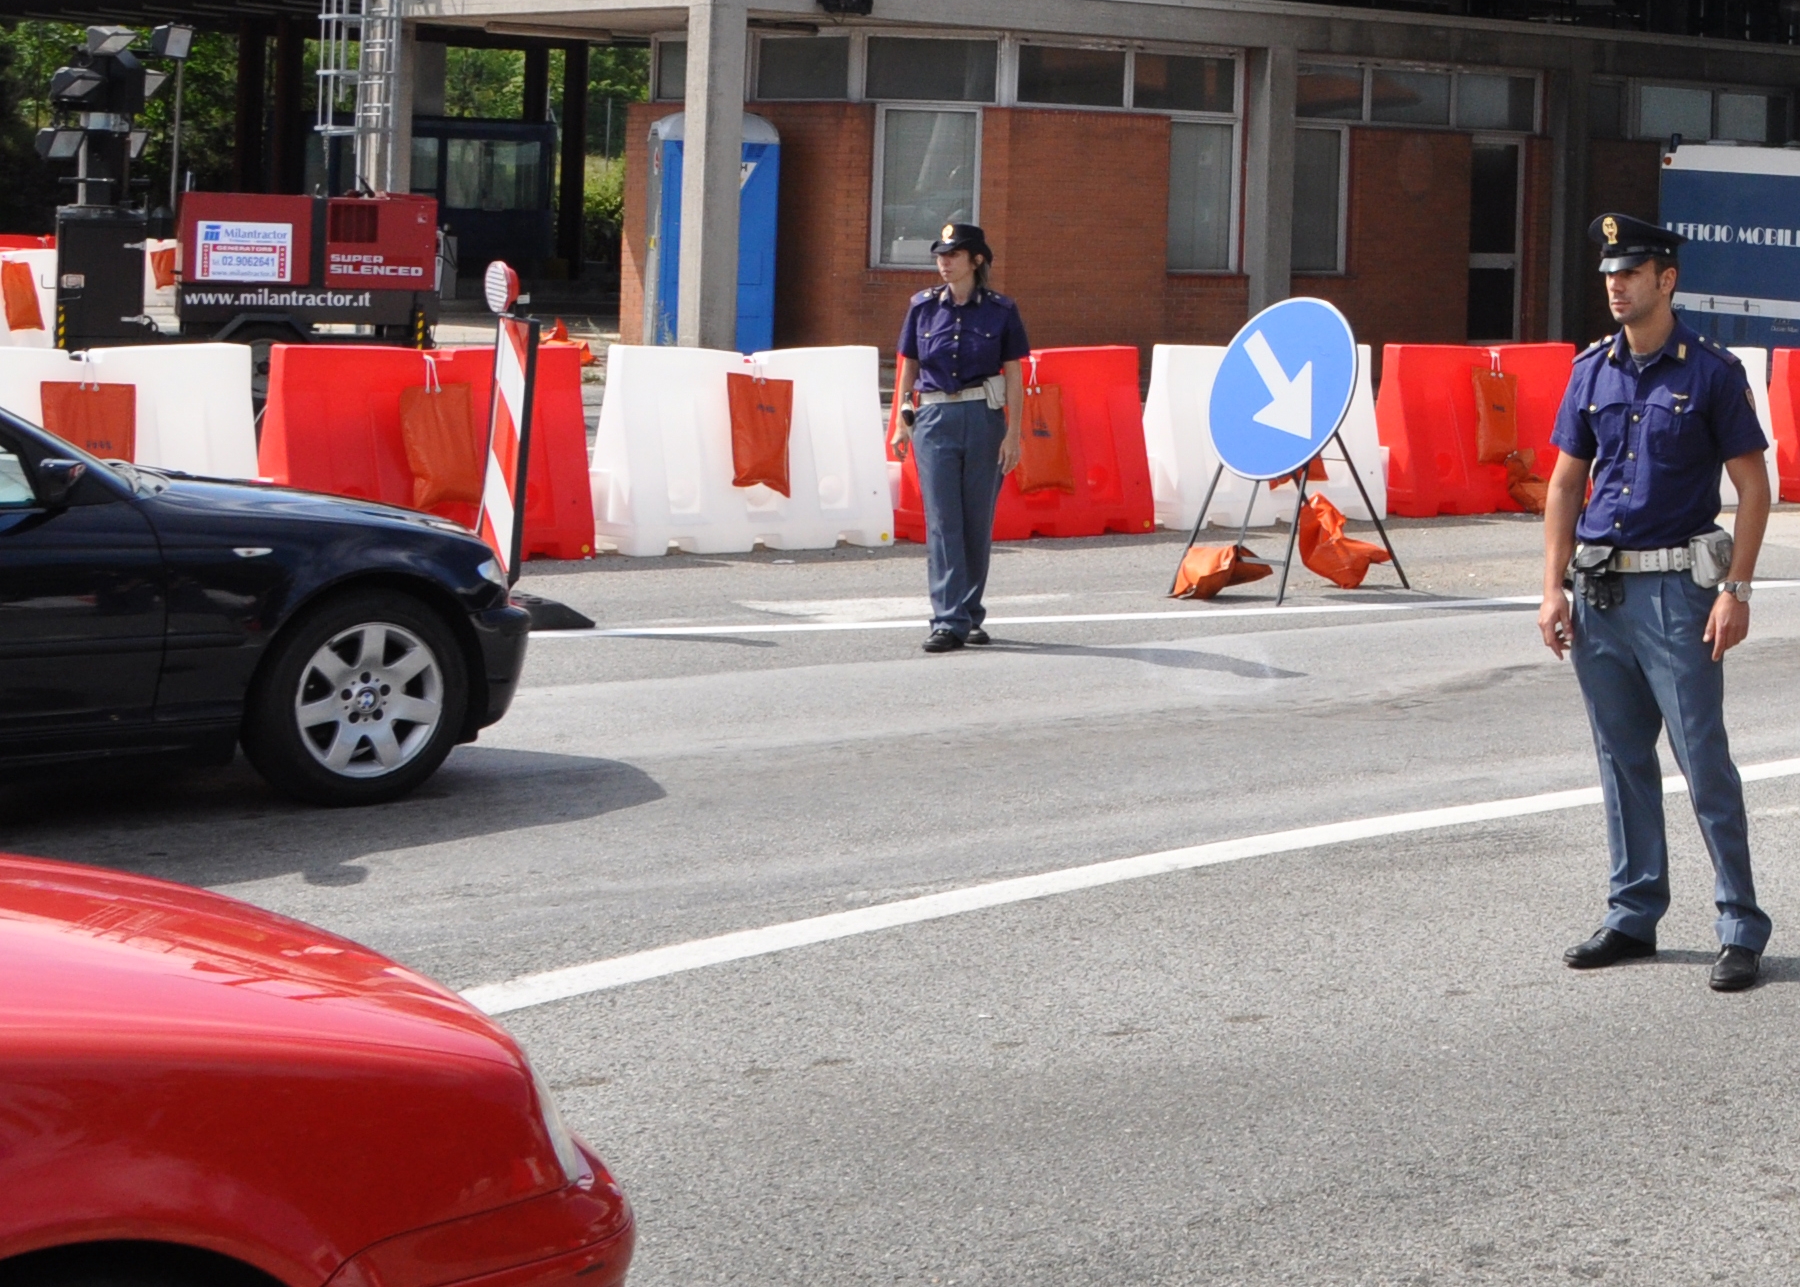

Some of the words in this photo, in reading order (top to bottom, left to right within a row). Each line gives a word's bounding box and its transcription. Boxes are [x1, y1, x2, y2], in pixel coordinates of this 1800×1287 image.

[224, 228, 287, 239] Milantractor
[330, 254, 384, 264] SUPER
[330, 264, 424, 277] SILENCED
[185, 289, 371, 307] www.milantractor.it
